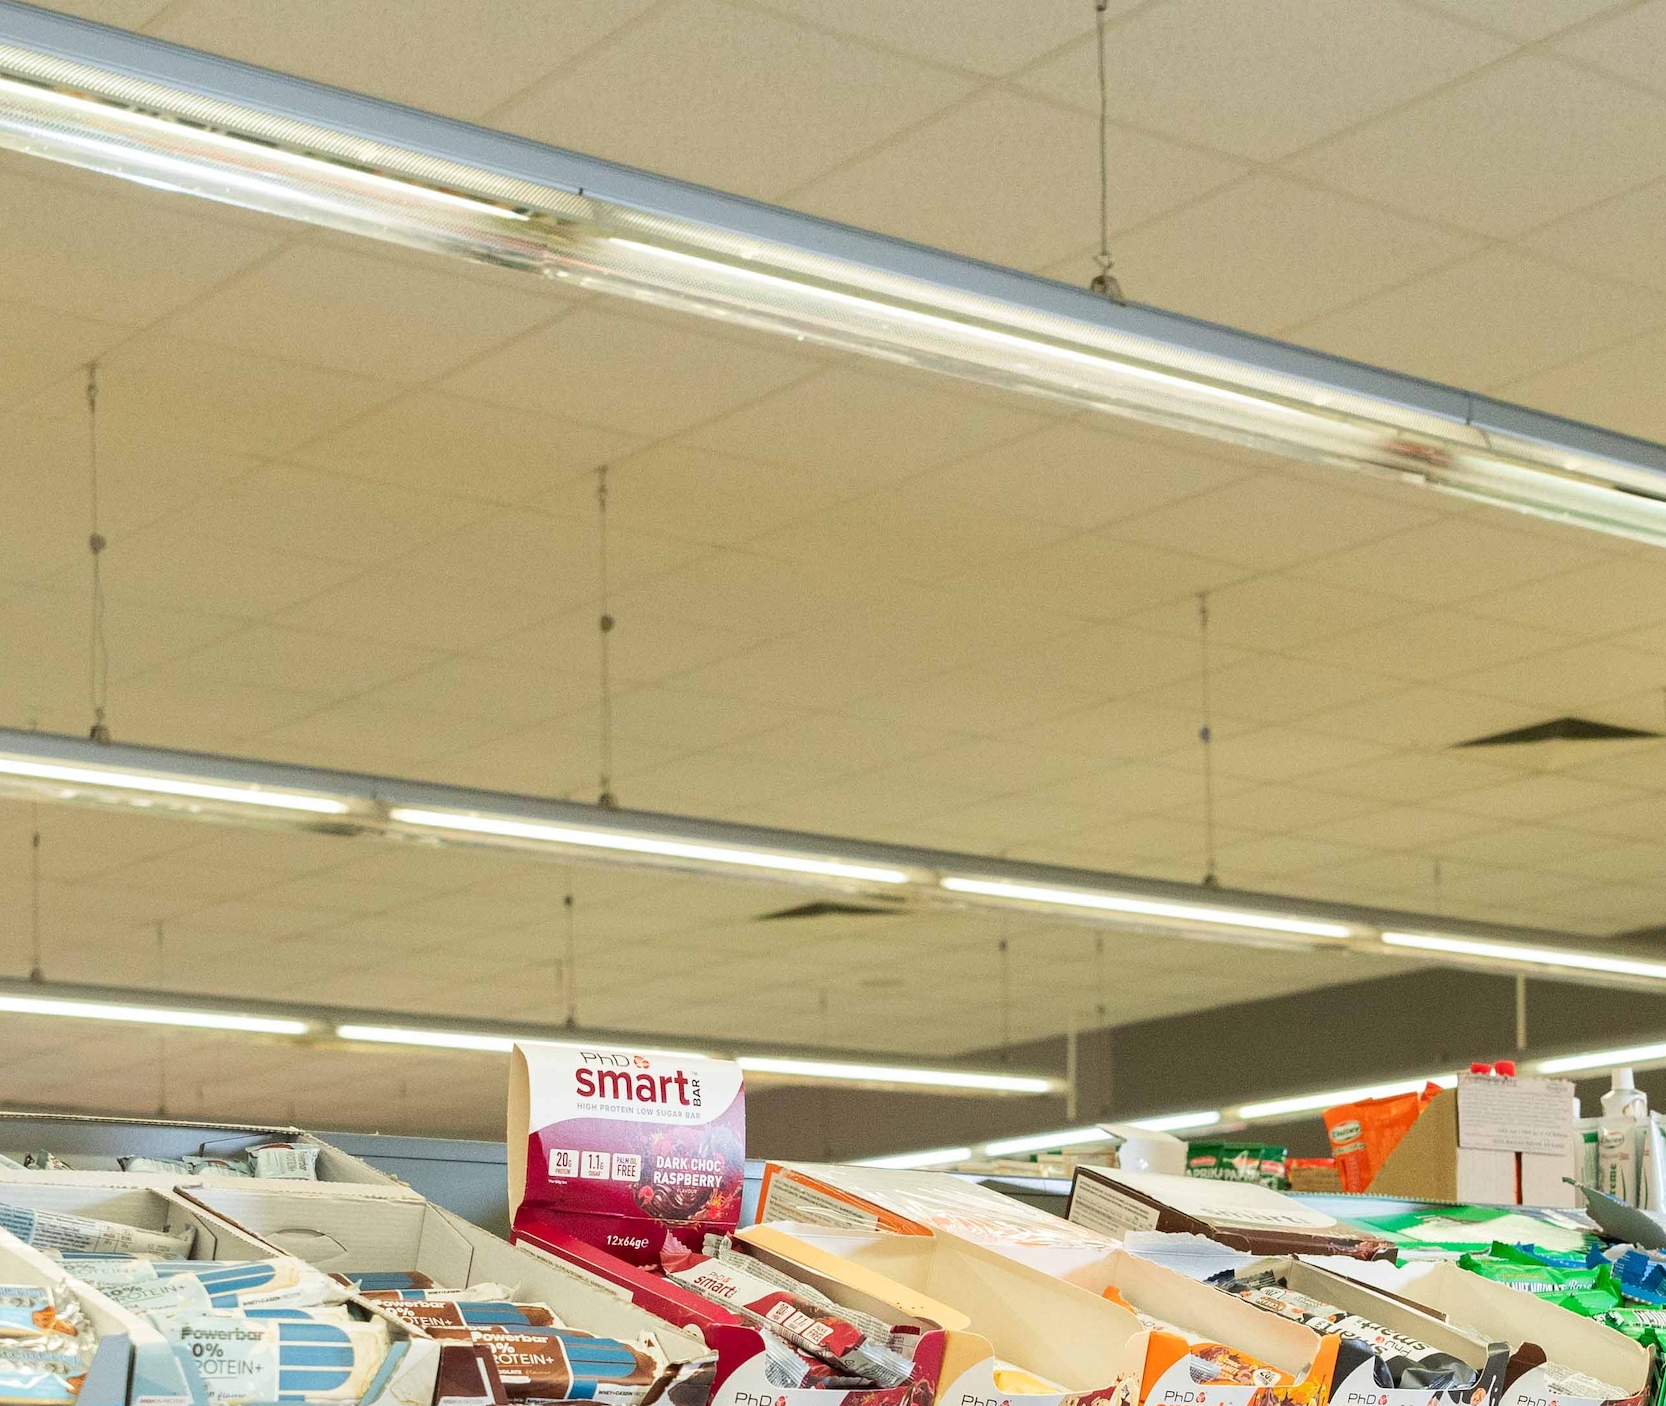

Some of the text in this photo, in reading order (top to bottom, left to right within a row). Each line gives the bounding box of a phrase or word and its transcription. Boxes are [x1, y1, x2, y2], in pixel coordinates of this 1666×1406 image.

[580, 1052, 630, 1067] PhD
[576, 1068, 702, 1107] smart BAR
[577, 1103, 598, 1111] HIGH
[600, 1105, 634, 1114] PROTEIN
[656, 1109, 683, 1118] SUGAR
[617, 1163, 636, 1177] FREE
[657, 1156, 721, 1172] DARK CHOC
[654, 1171, 722, 1187] RASPBERRY
[736, 1393, 771, 1406] PhD
[1164, 1390, 1195, 1404] PhD
